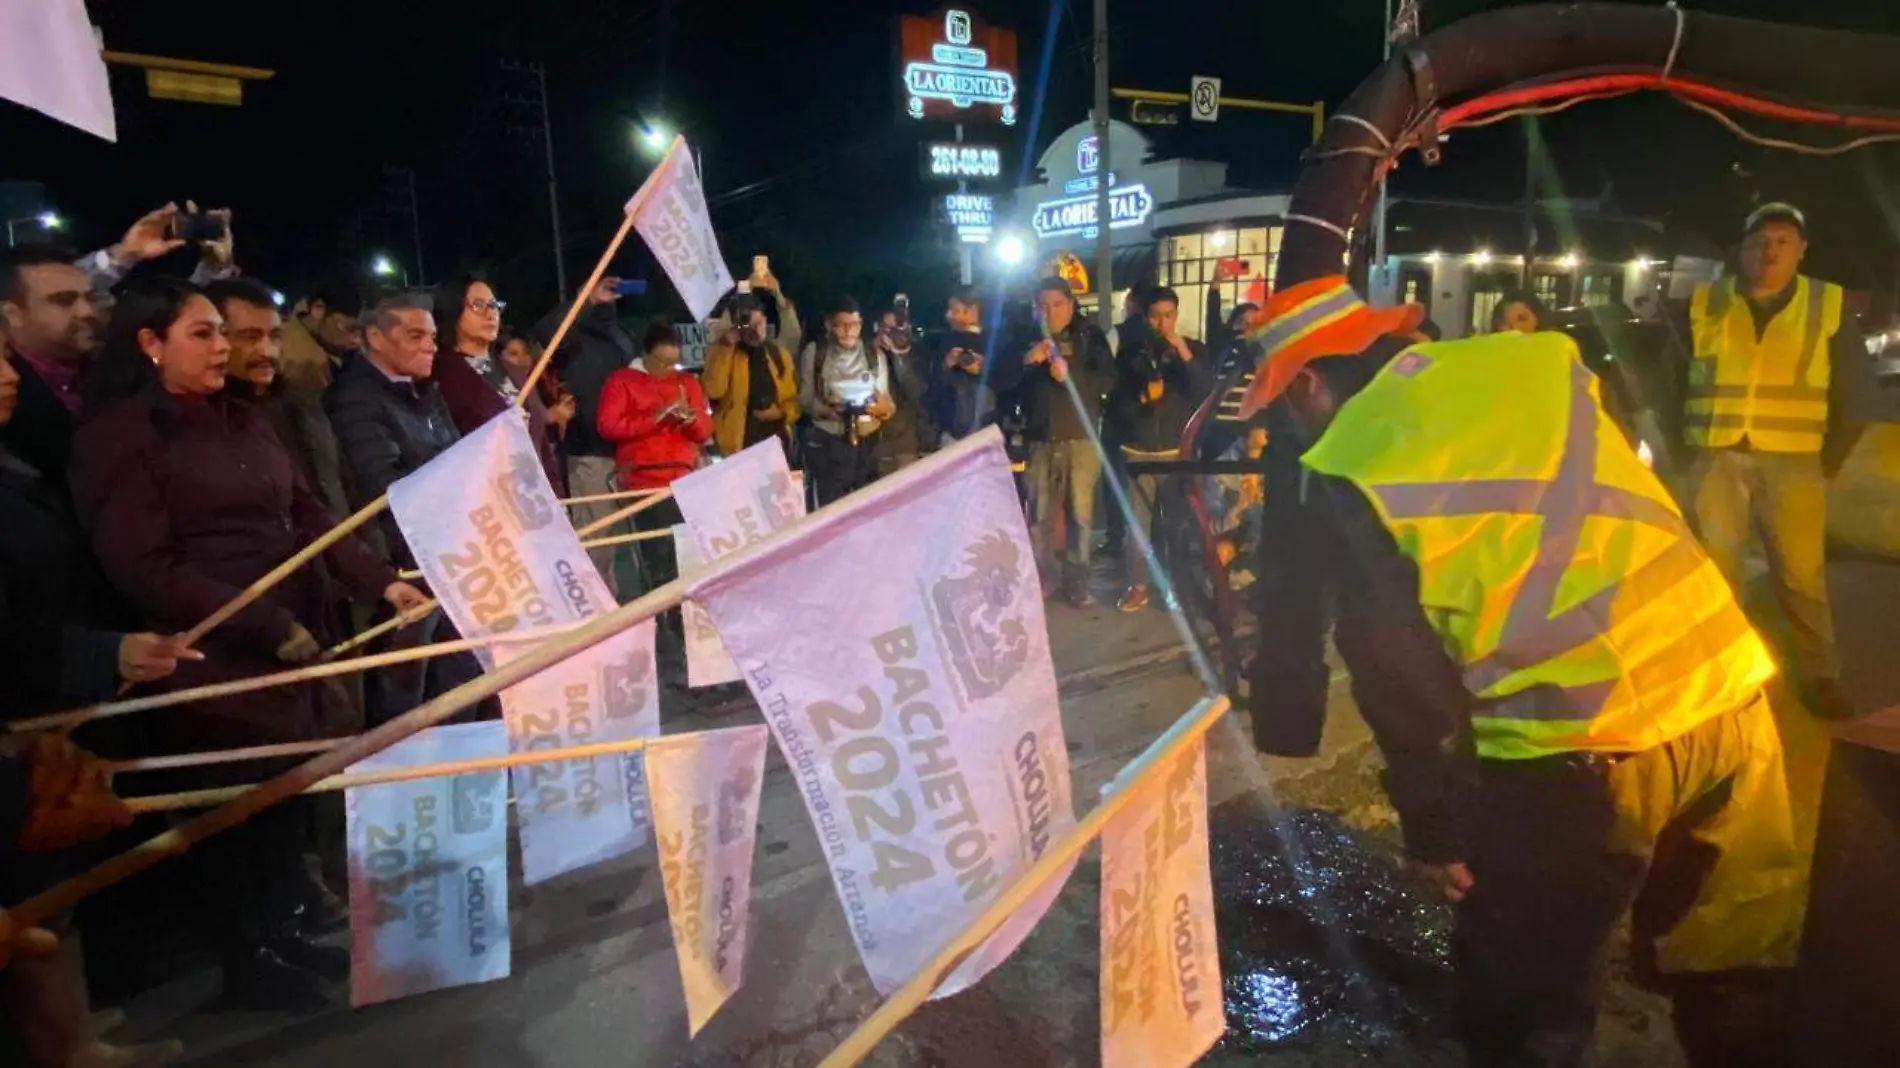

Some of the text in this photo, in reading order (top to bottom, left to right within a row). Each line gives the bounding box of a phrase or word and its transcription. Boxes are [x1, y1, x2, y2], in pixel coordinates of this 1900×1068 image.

[913, 71, 1007, 97] LA ORIENTAL
[946, 195, 993, 211] DRIVE
[948, 211, 992, 225] THRU
[1042, 194, 1138, 229] LA ORIETAL
[751, 661, 772, 693] La
[565, 683, 602, 819] BACETÓN
[624, 750, 648, 826] HOLULA
[803, 684, 936, 894] 2024
[870, 625, 999, 901] BACHETÓN
[467, 866, 487, 958] CHOLULA
[1173, 892, 1201, 1019] CHOLULA
